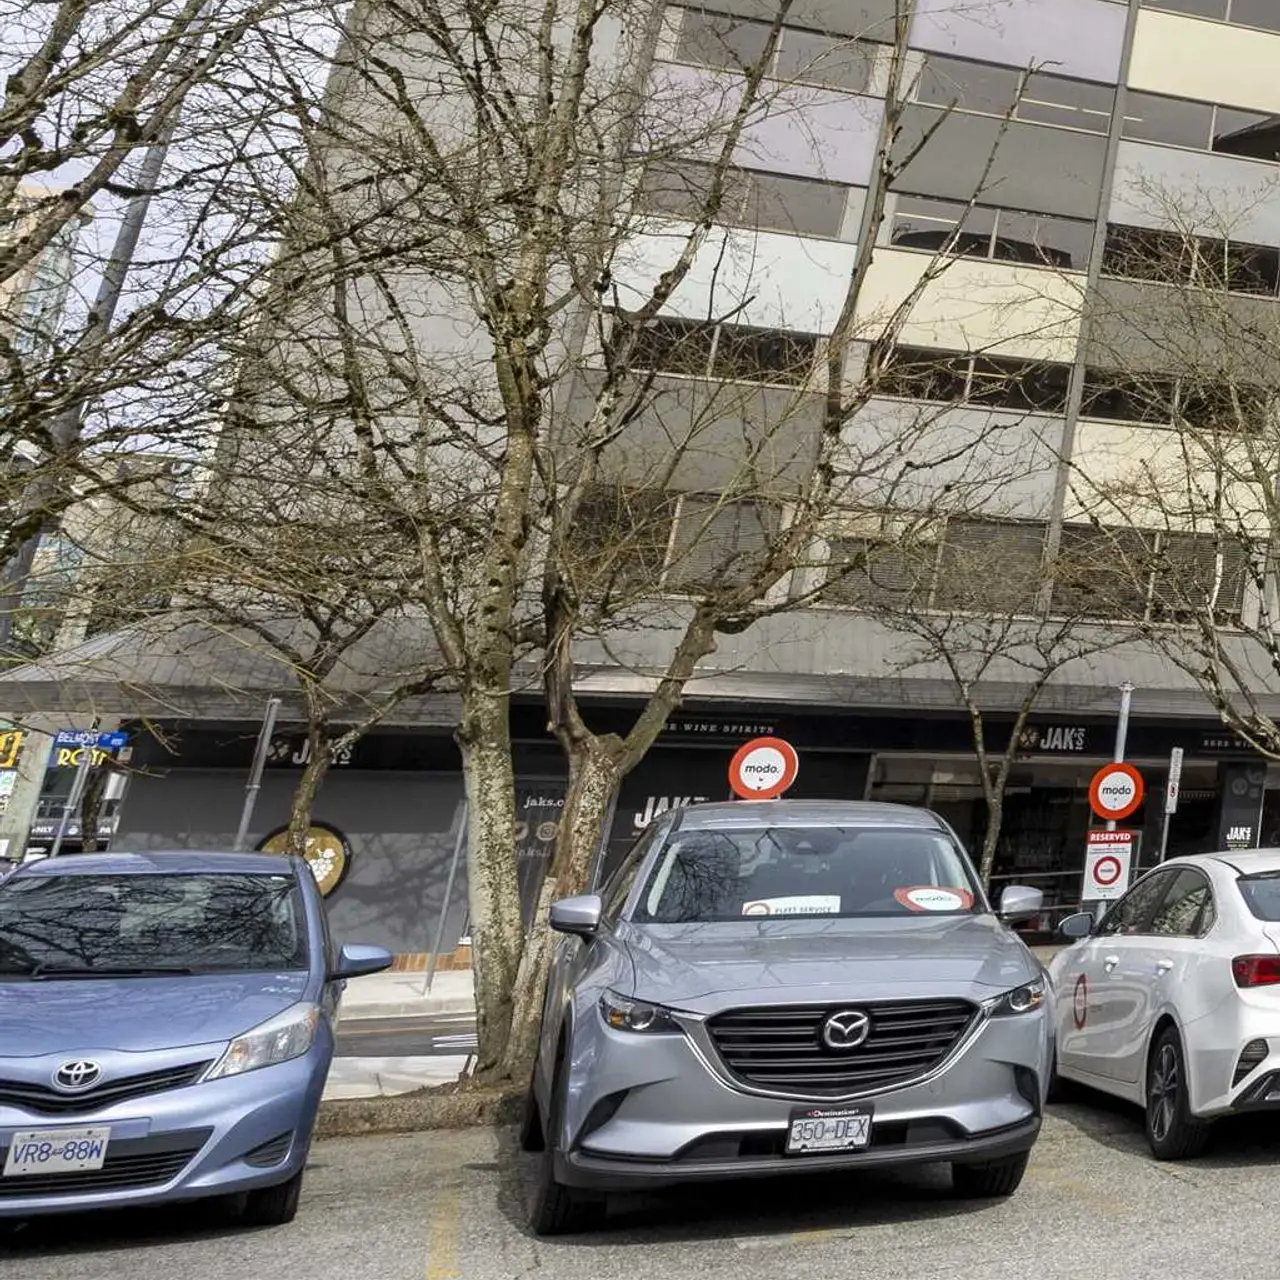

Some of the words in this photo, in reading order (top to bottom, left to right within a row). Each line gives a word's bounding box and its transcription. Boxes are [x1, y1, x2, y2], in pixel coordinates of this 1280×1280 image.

[684, 723, 717, 732] WINE
[723, 725, 775, 734] SPIRITS
[1102, 785, 1132, 796] modo
[1090, 832, 1132, 842] RESERVED
[834, 1118, 868, 1139] DEX
[13, 1142, 52, 1164] VR8
[62, 1139, 104, 1161] 88W
